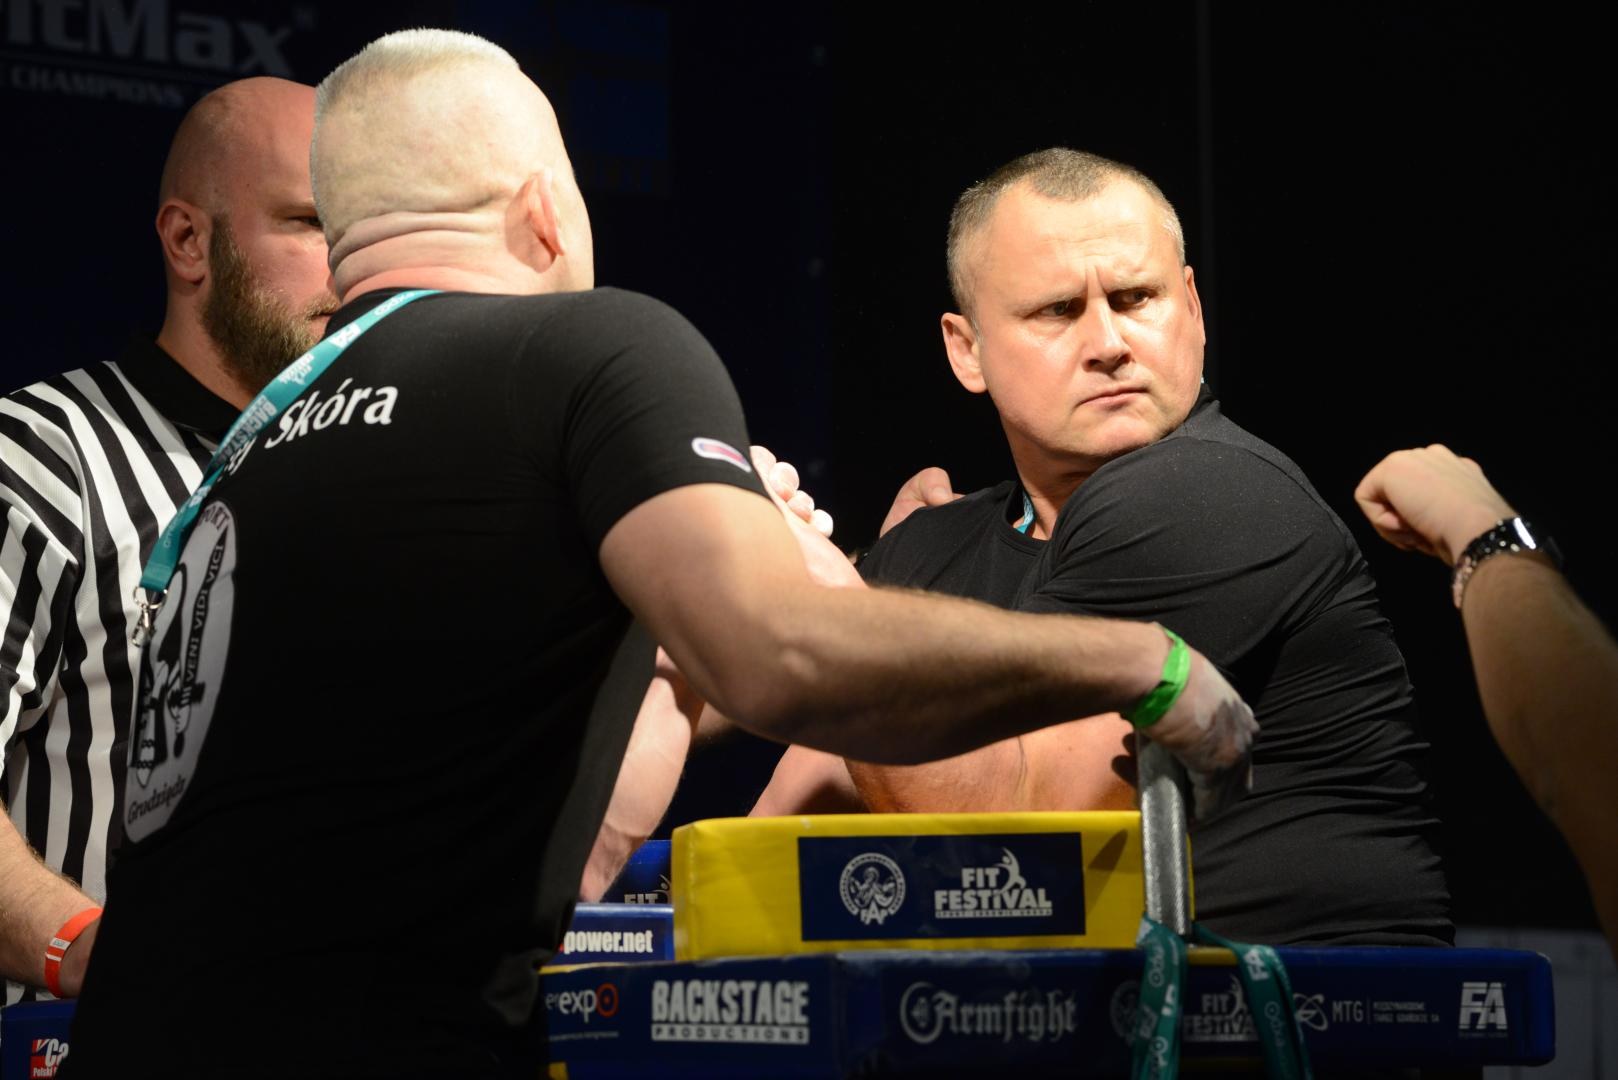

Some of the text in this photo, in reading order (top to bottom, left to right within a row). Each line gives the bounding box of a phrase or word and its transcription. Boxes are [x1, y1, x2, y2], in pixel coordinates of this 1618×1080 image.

[0, 0, 297, 78] itMax
[9, 65, 186, 108] CHAMPIONS
[264, 377, 399, 450] Skóra
[186, 545, 224, 682] VENI VIDI VICI
[961, 867, 1000, 888] FIT
[560, 930, 654, 955] power.net
[544, 983, 620, 1024] erexpo
[652, 979, 810, 1025] BACKSTAGE
[929, 988, 1077, 1044] Armfight
[1202, 993, 1231, 1014] FIT
[1332, 1001, 1364, 1023] MTG
[1458, 981, 1509, 1030] FA
[655, 1027, 804, 1040] PRODUCTIONS
[1184, 1013, 1258, 1035] FESTIVA
